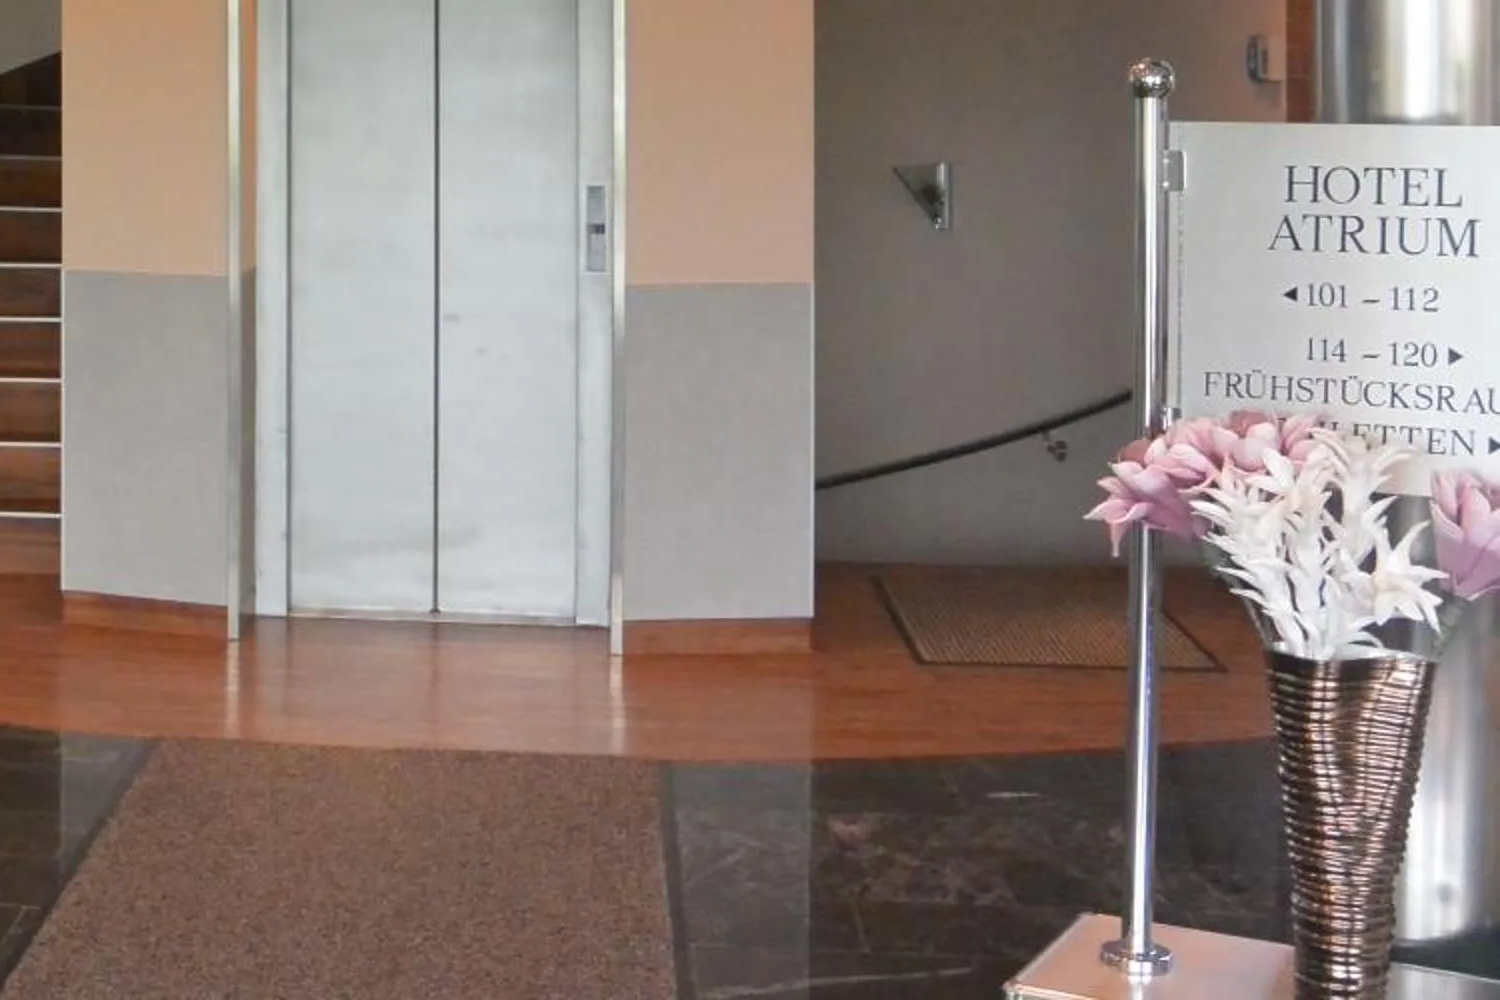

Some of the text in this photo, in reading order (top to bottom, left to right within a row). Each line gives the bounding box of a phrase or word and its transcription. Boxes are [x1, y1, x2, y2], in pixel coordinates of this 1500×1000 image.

[1284, 165, 1464, 208] HOTEL
[1267, 213, 1481, 258] ATRIUM
[1307, 281, 1348, 309] 101
[1389, 285, 1440, 313] 112
[1306, 336, 1347, 363] 114
[1388, 341, 1439, 368] 120
